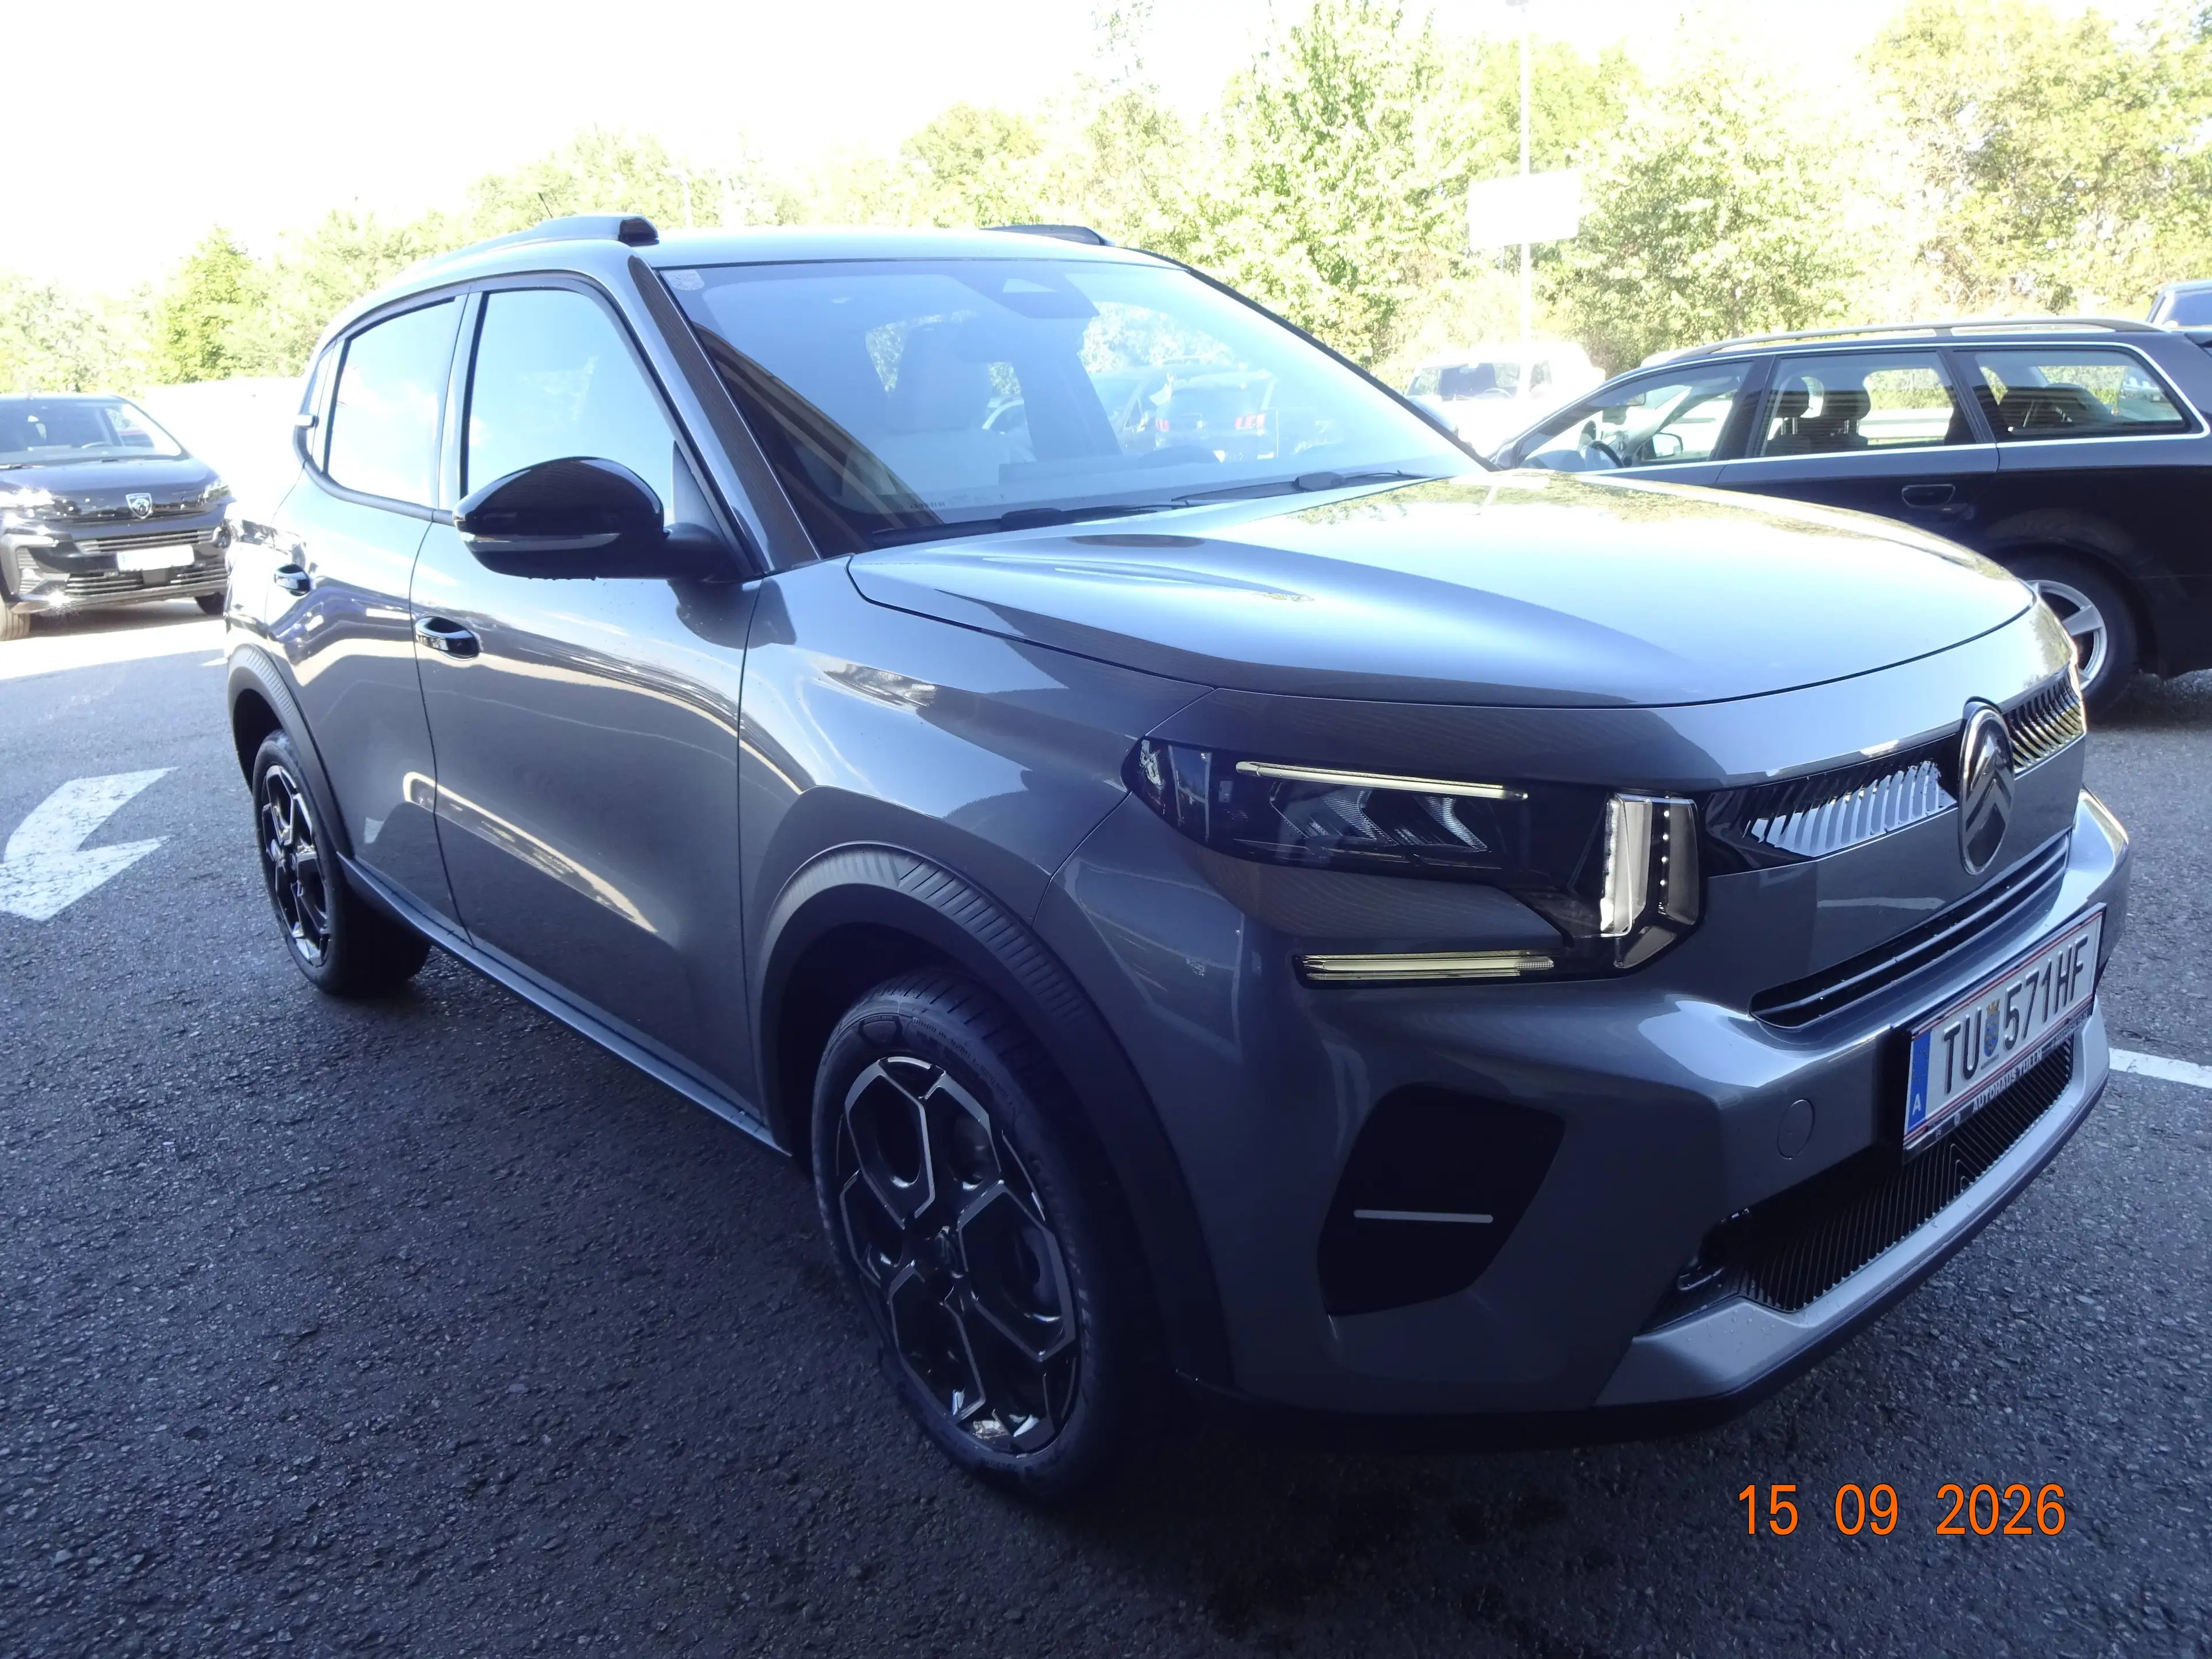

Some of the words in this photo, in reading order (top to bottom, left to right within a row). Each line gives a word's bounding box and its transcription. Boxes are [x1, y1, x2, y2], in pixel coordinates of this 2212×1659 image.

[1944, 1006, 1983, 1094] TU
[2003, 934, 2088, 1051] 571HF
[1911, 1093, 1922, 1116] A
[1972, 1069, 2017, 1115] AUTOHAUS
